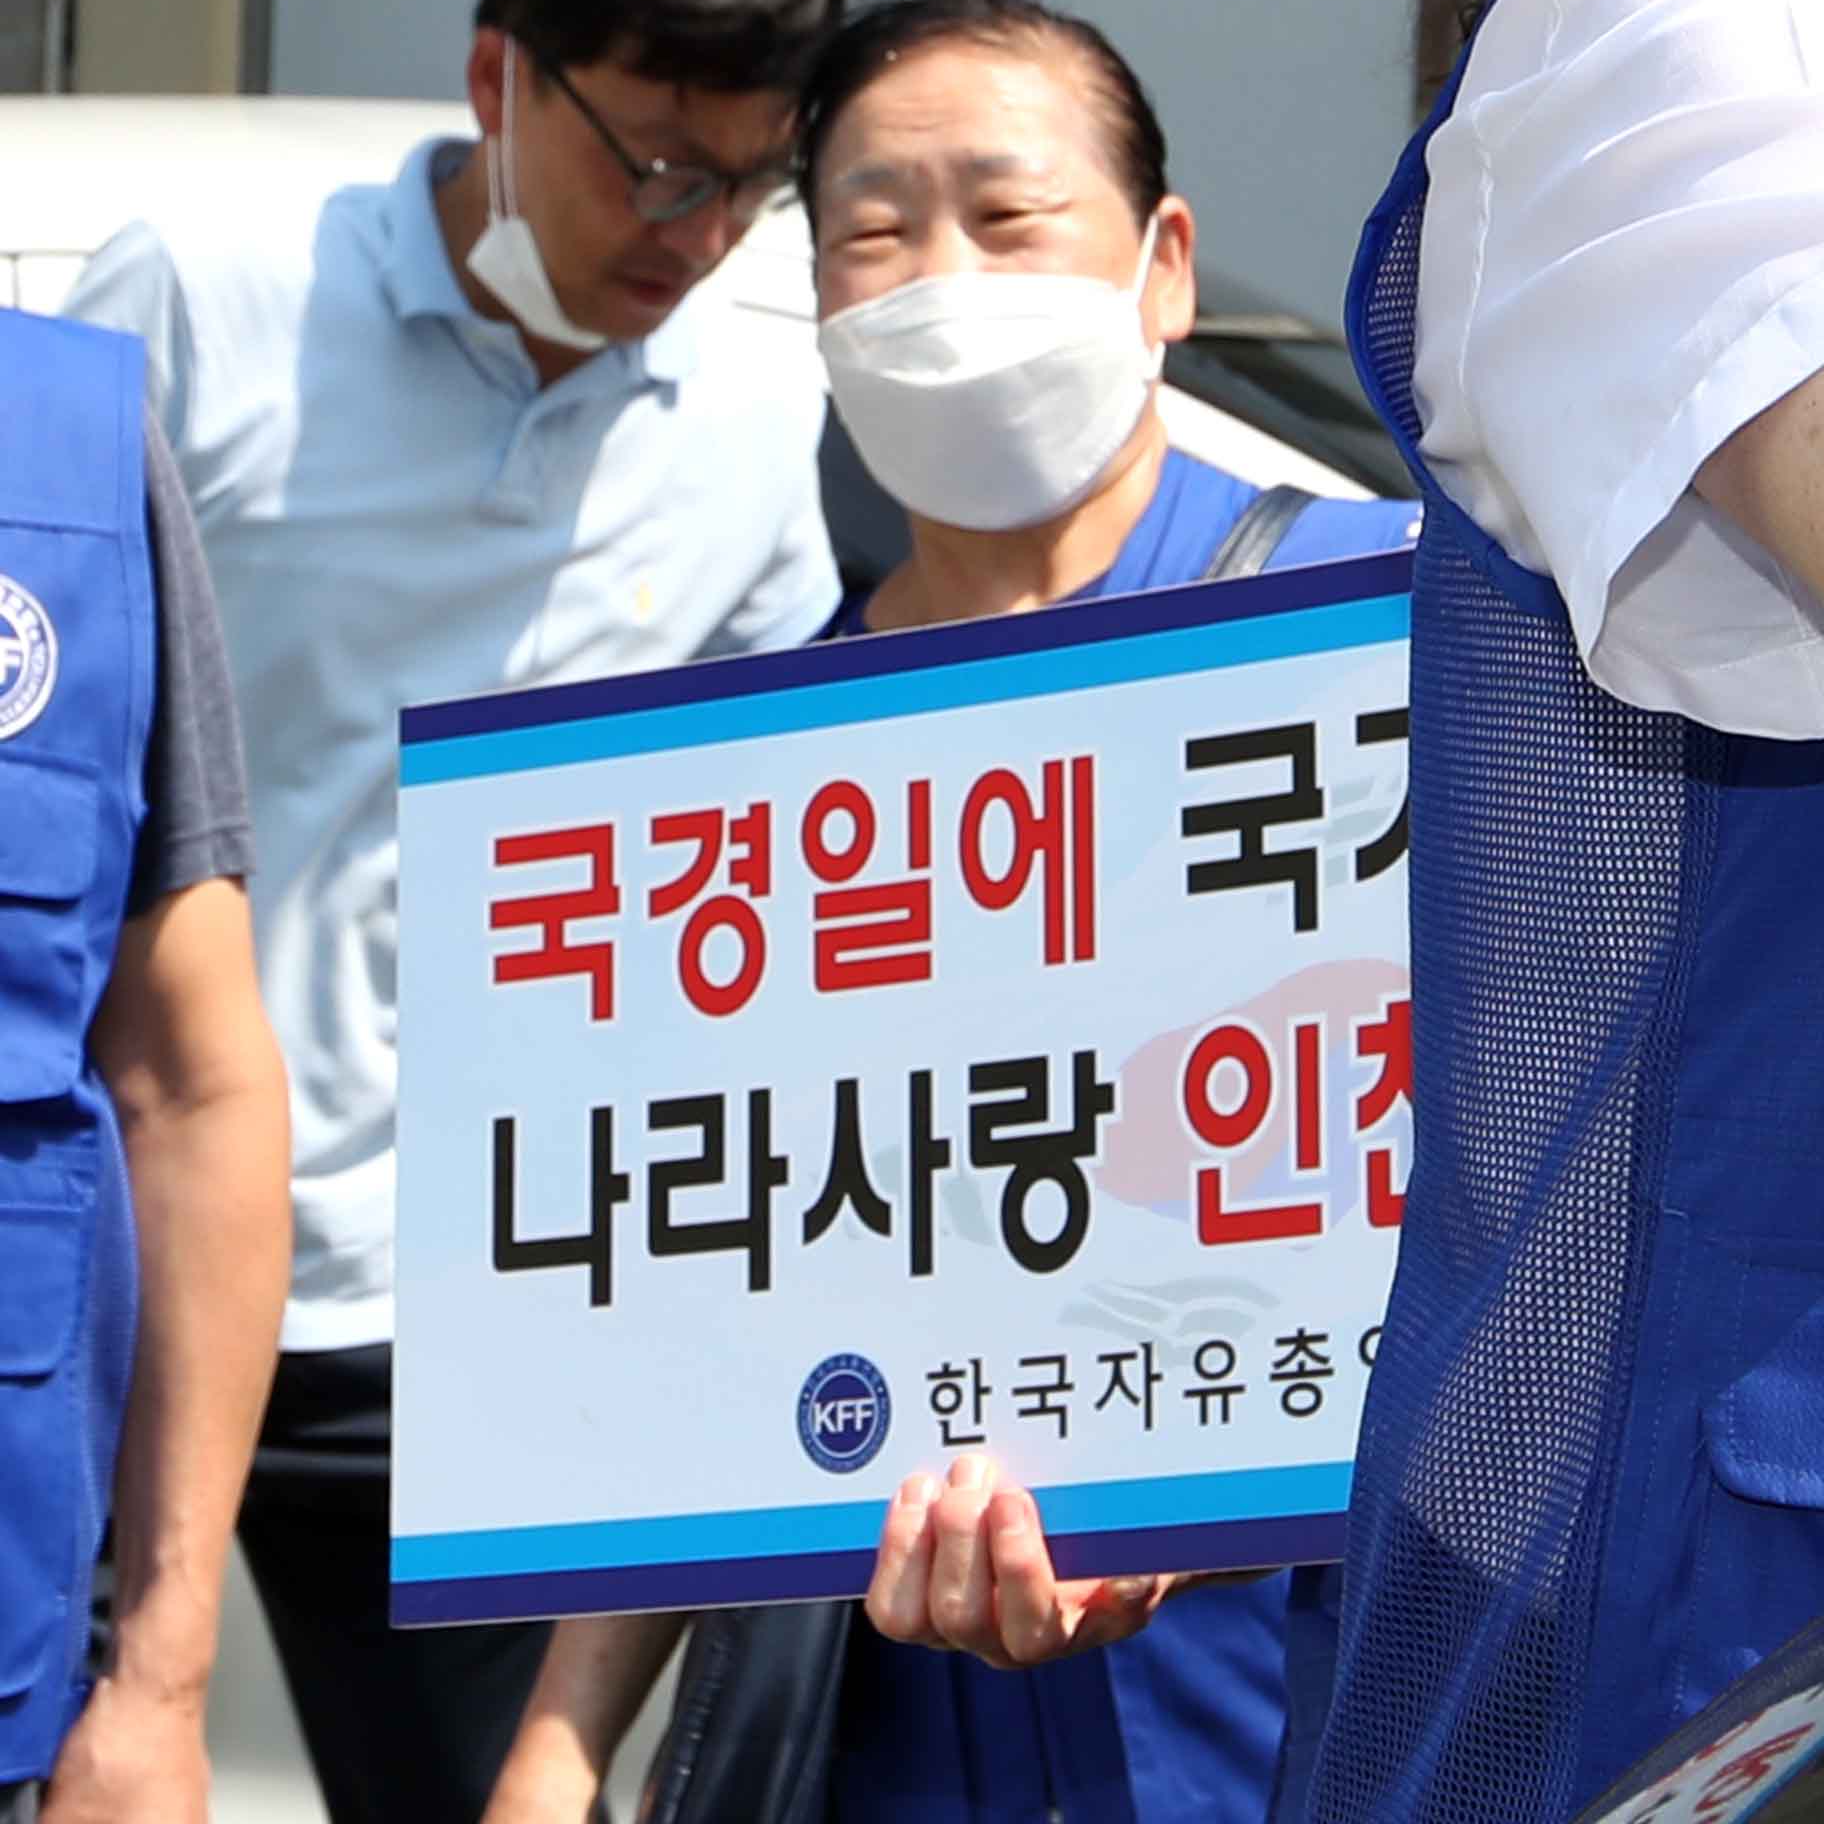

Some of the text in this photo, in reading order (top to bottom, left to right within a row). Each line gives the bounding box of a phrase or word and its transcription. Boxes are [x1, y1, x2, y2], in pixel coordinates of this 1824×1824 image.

[490, 755, 1097, 1021] 국경일에
[492, 1049, 1115, 1308] 나라사랑
[813, 1397, 876, 1435] KFF
[926, 1325, 1384, 1447] 한국자유총
